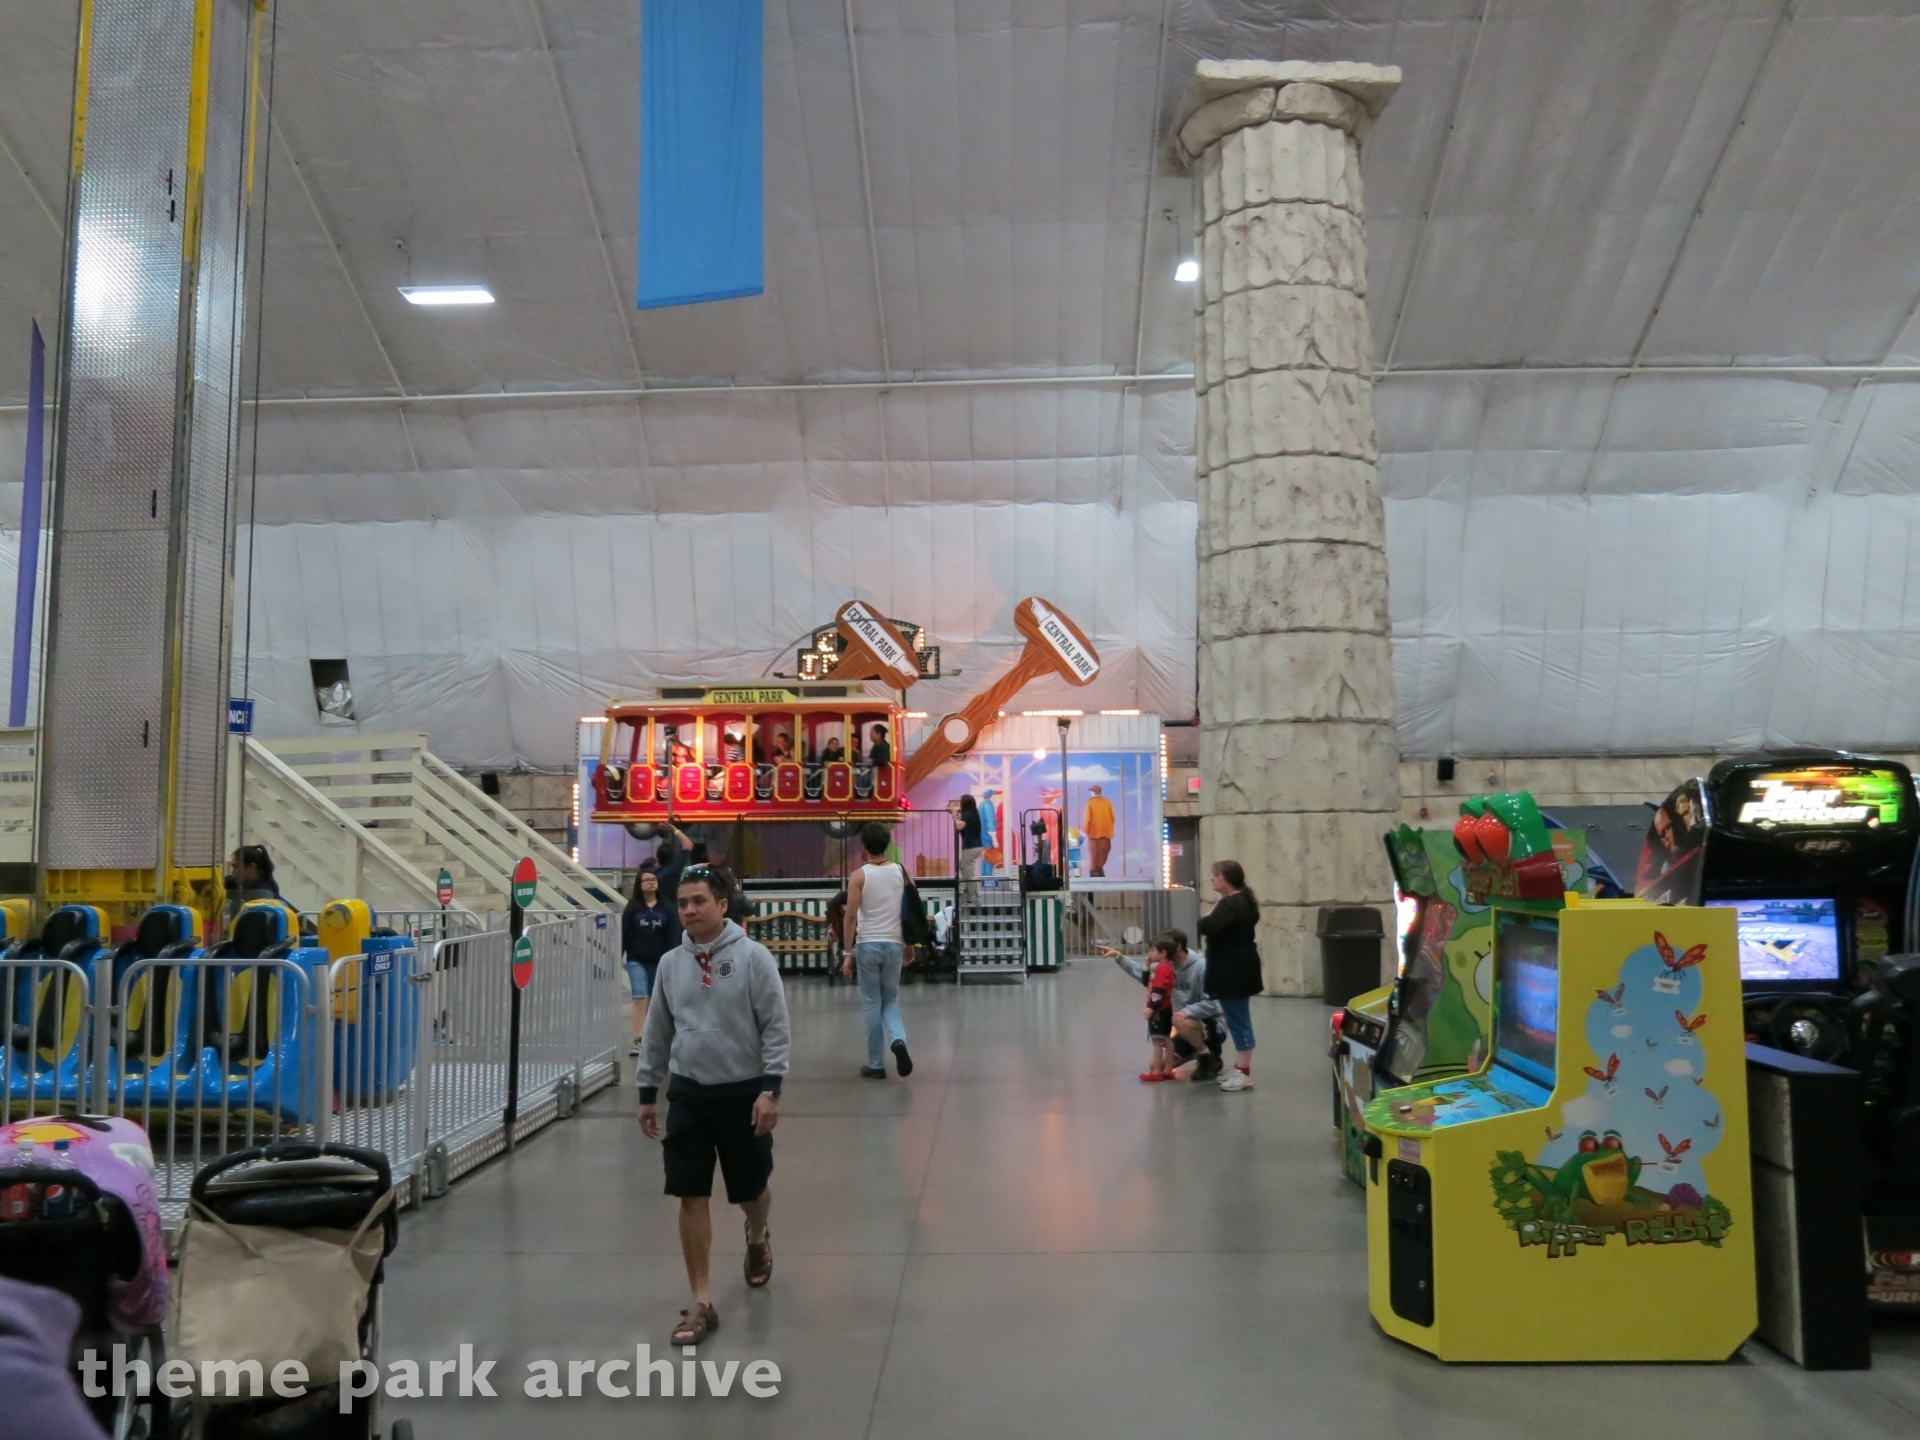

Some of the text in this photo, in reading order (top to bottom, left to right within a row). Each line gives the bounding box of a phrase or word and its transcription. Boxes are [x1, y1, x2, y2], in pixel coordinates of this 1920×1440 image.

[846, 607, 878, 642] CENTRAL
[875, 636, 898, 661] PARK
[1044, 620, 1094, 676] CENTRAL PARK
[713, 690, 785, 704] CENTRAL PARK
[1750, 780, 1784, 788] THE
[1738, 802, 1869, 823] FURIOUS
[374, 961, 392, 971] ONLY
[375, 954, 391, 963] EXIT
[1517, 1213, 1728, 1259] Ripper Ribbit
